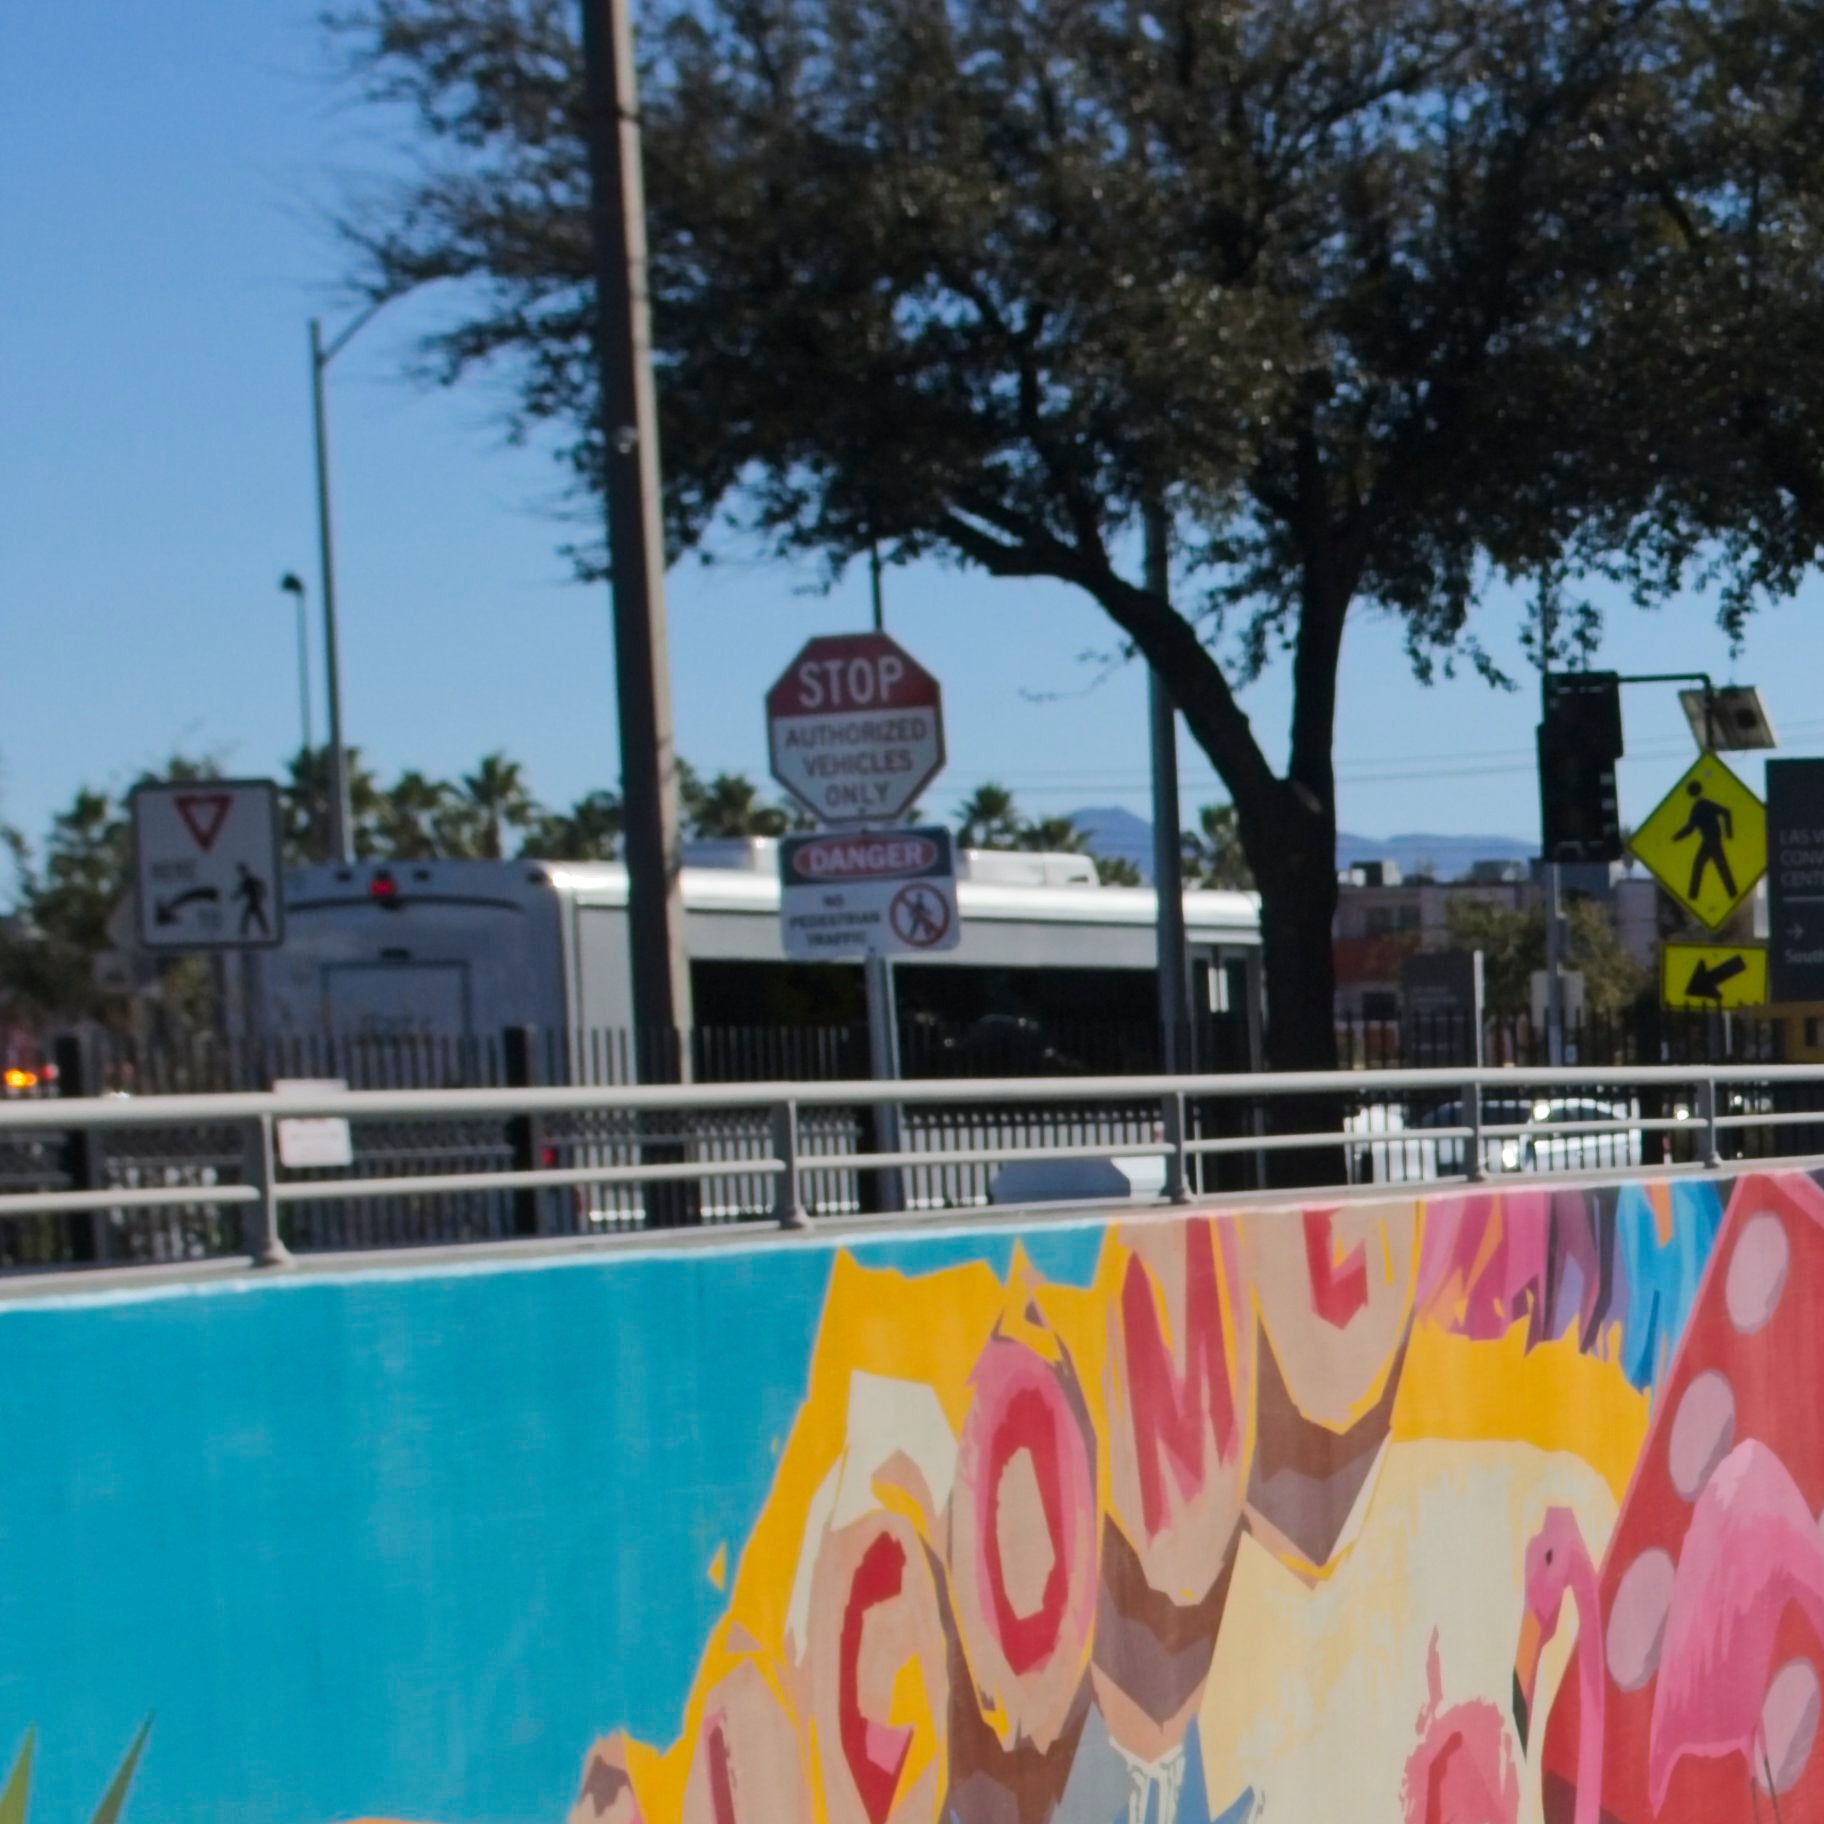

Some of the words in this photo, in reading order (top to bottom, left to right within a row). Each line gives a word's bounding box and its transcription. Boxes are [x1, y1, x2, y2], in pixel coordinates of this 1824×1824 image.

[799, 656, 904, 708] STOP
[785, 718, 927, 749] AUTHORIZED
[802, 750, 913, 779] VEHICLES
[825, 781, 889, 806] ONLY
[1779, 829, 1809, 845] LAS
[810, 842, 923, 871] DANGER
[789, 912, 881, 928] PEDESTRIAN
